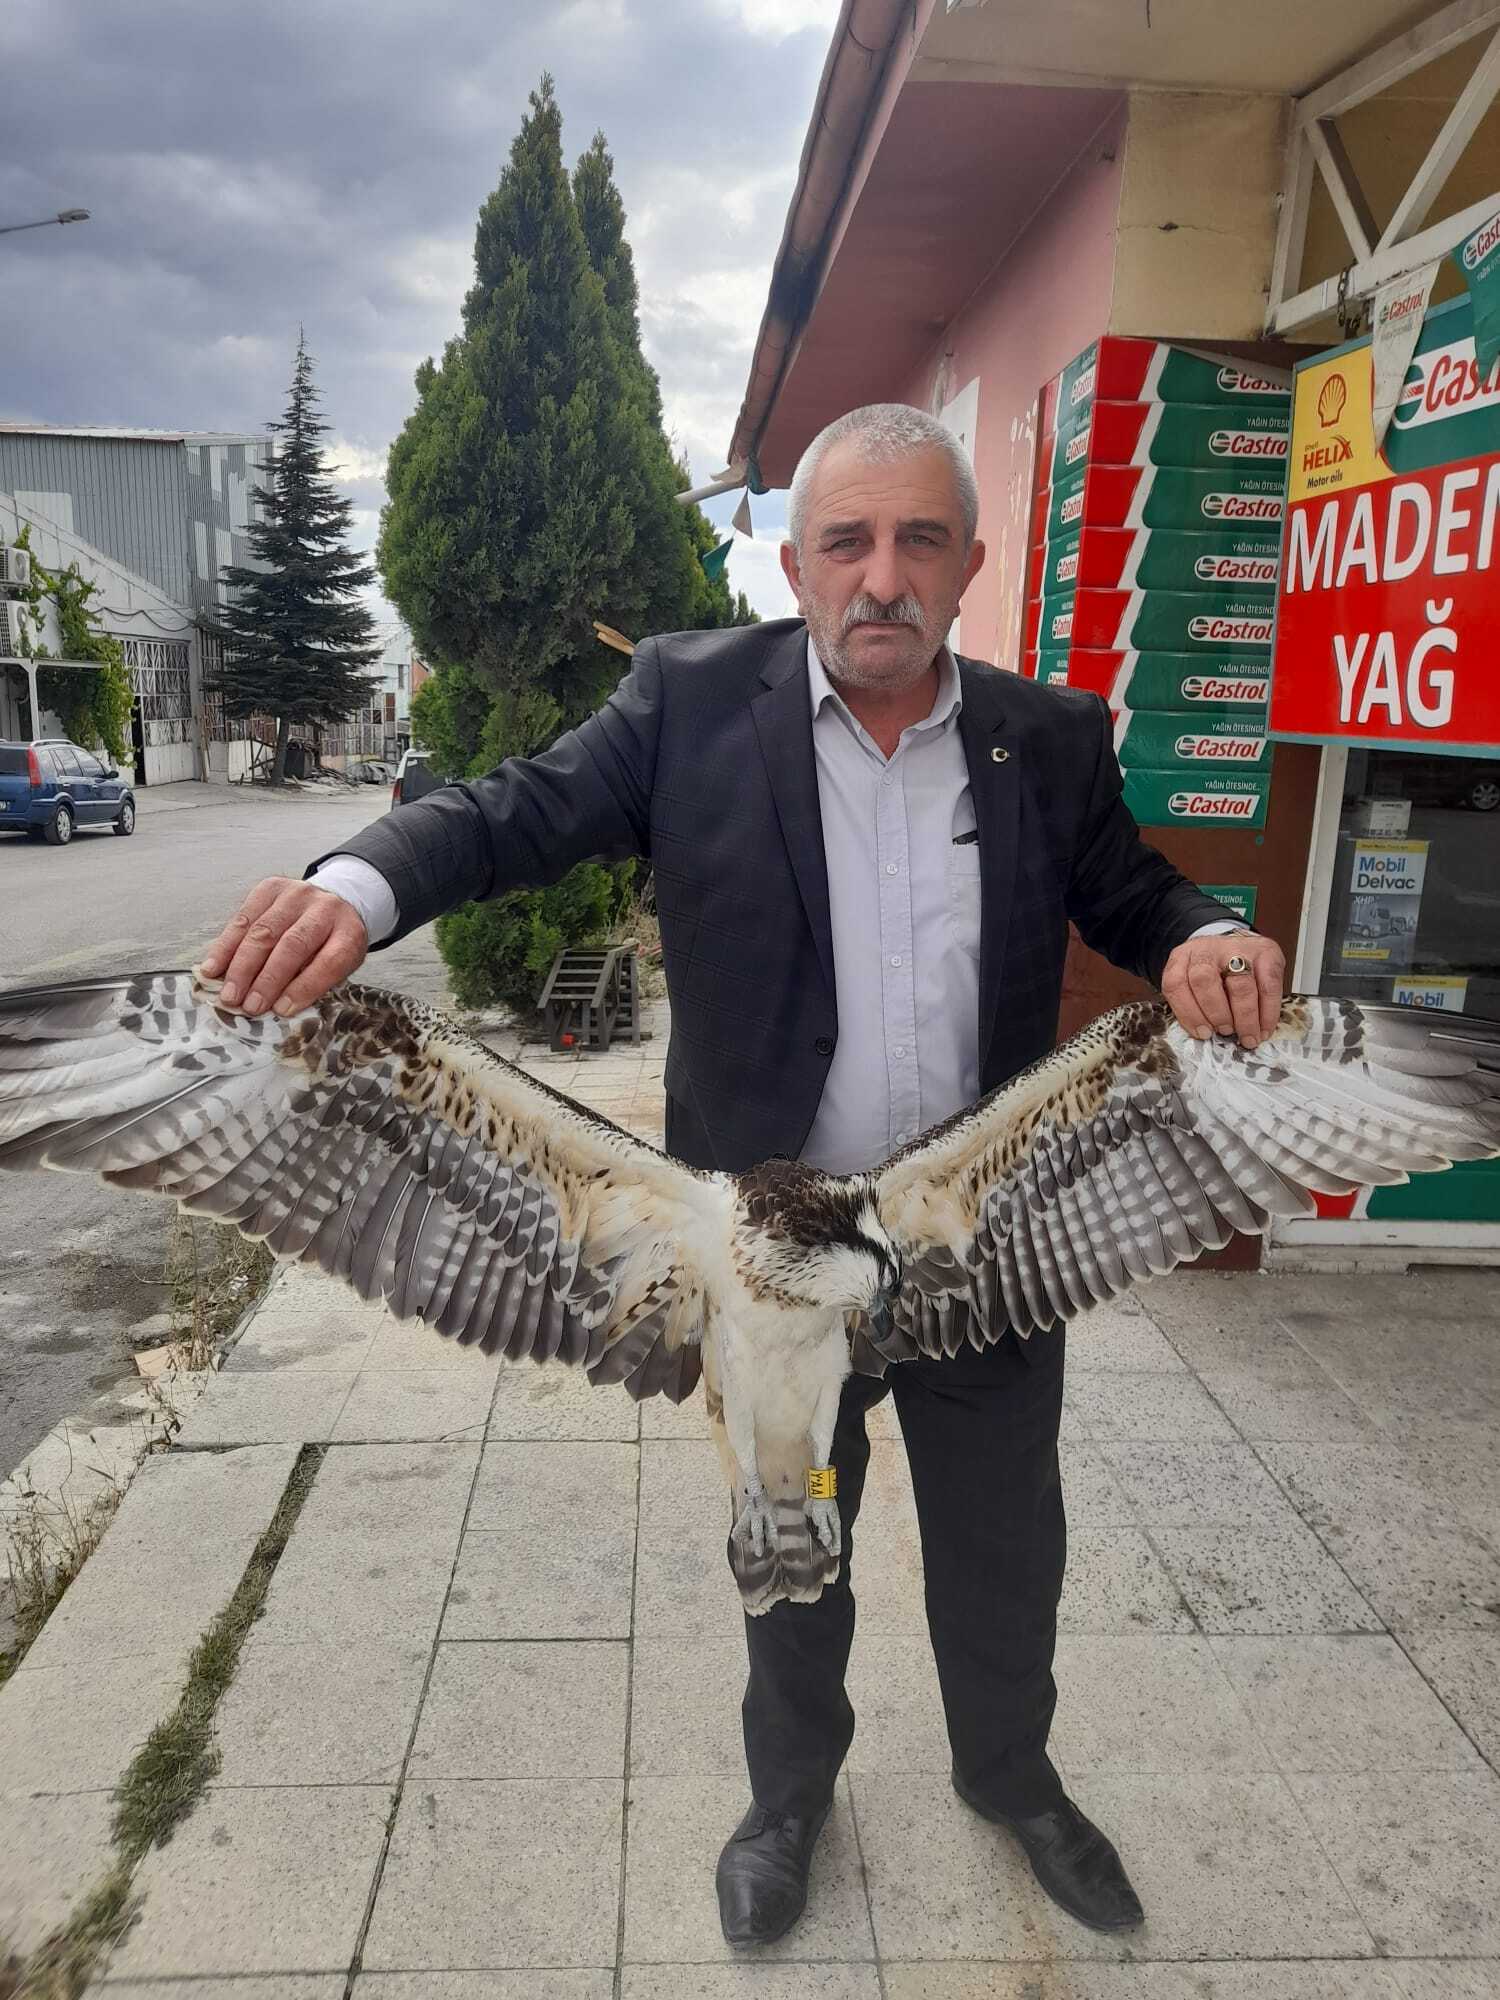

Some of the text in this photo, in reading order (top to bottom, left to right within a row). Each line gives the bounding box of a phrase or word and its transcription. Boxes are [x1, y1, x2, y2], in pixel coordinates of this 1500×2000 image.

[1303, 437, 1353, 472] HELIX
[1307, 476, 1329, 488] Motor
[1209, 621, 1273, 640] Castrol
[1333, 597, 1458, 728] YAĞ
[1203, 680, 1266, 700] Castrol
[1196, 739, 1259, 757] Castrol
[1189, 797, 1252, 815] Castrol
[1359, 857, 1406, 872] Mobil
[1356, 874, 1415, 889] Delvac
[1397, 990, 1444, 1007] Mobil
